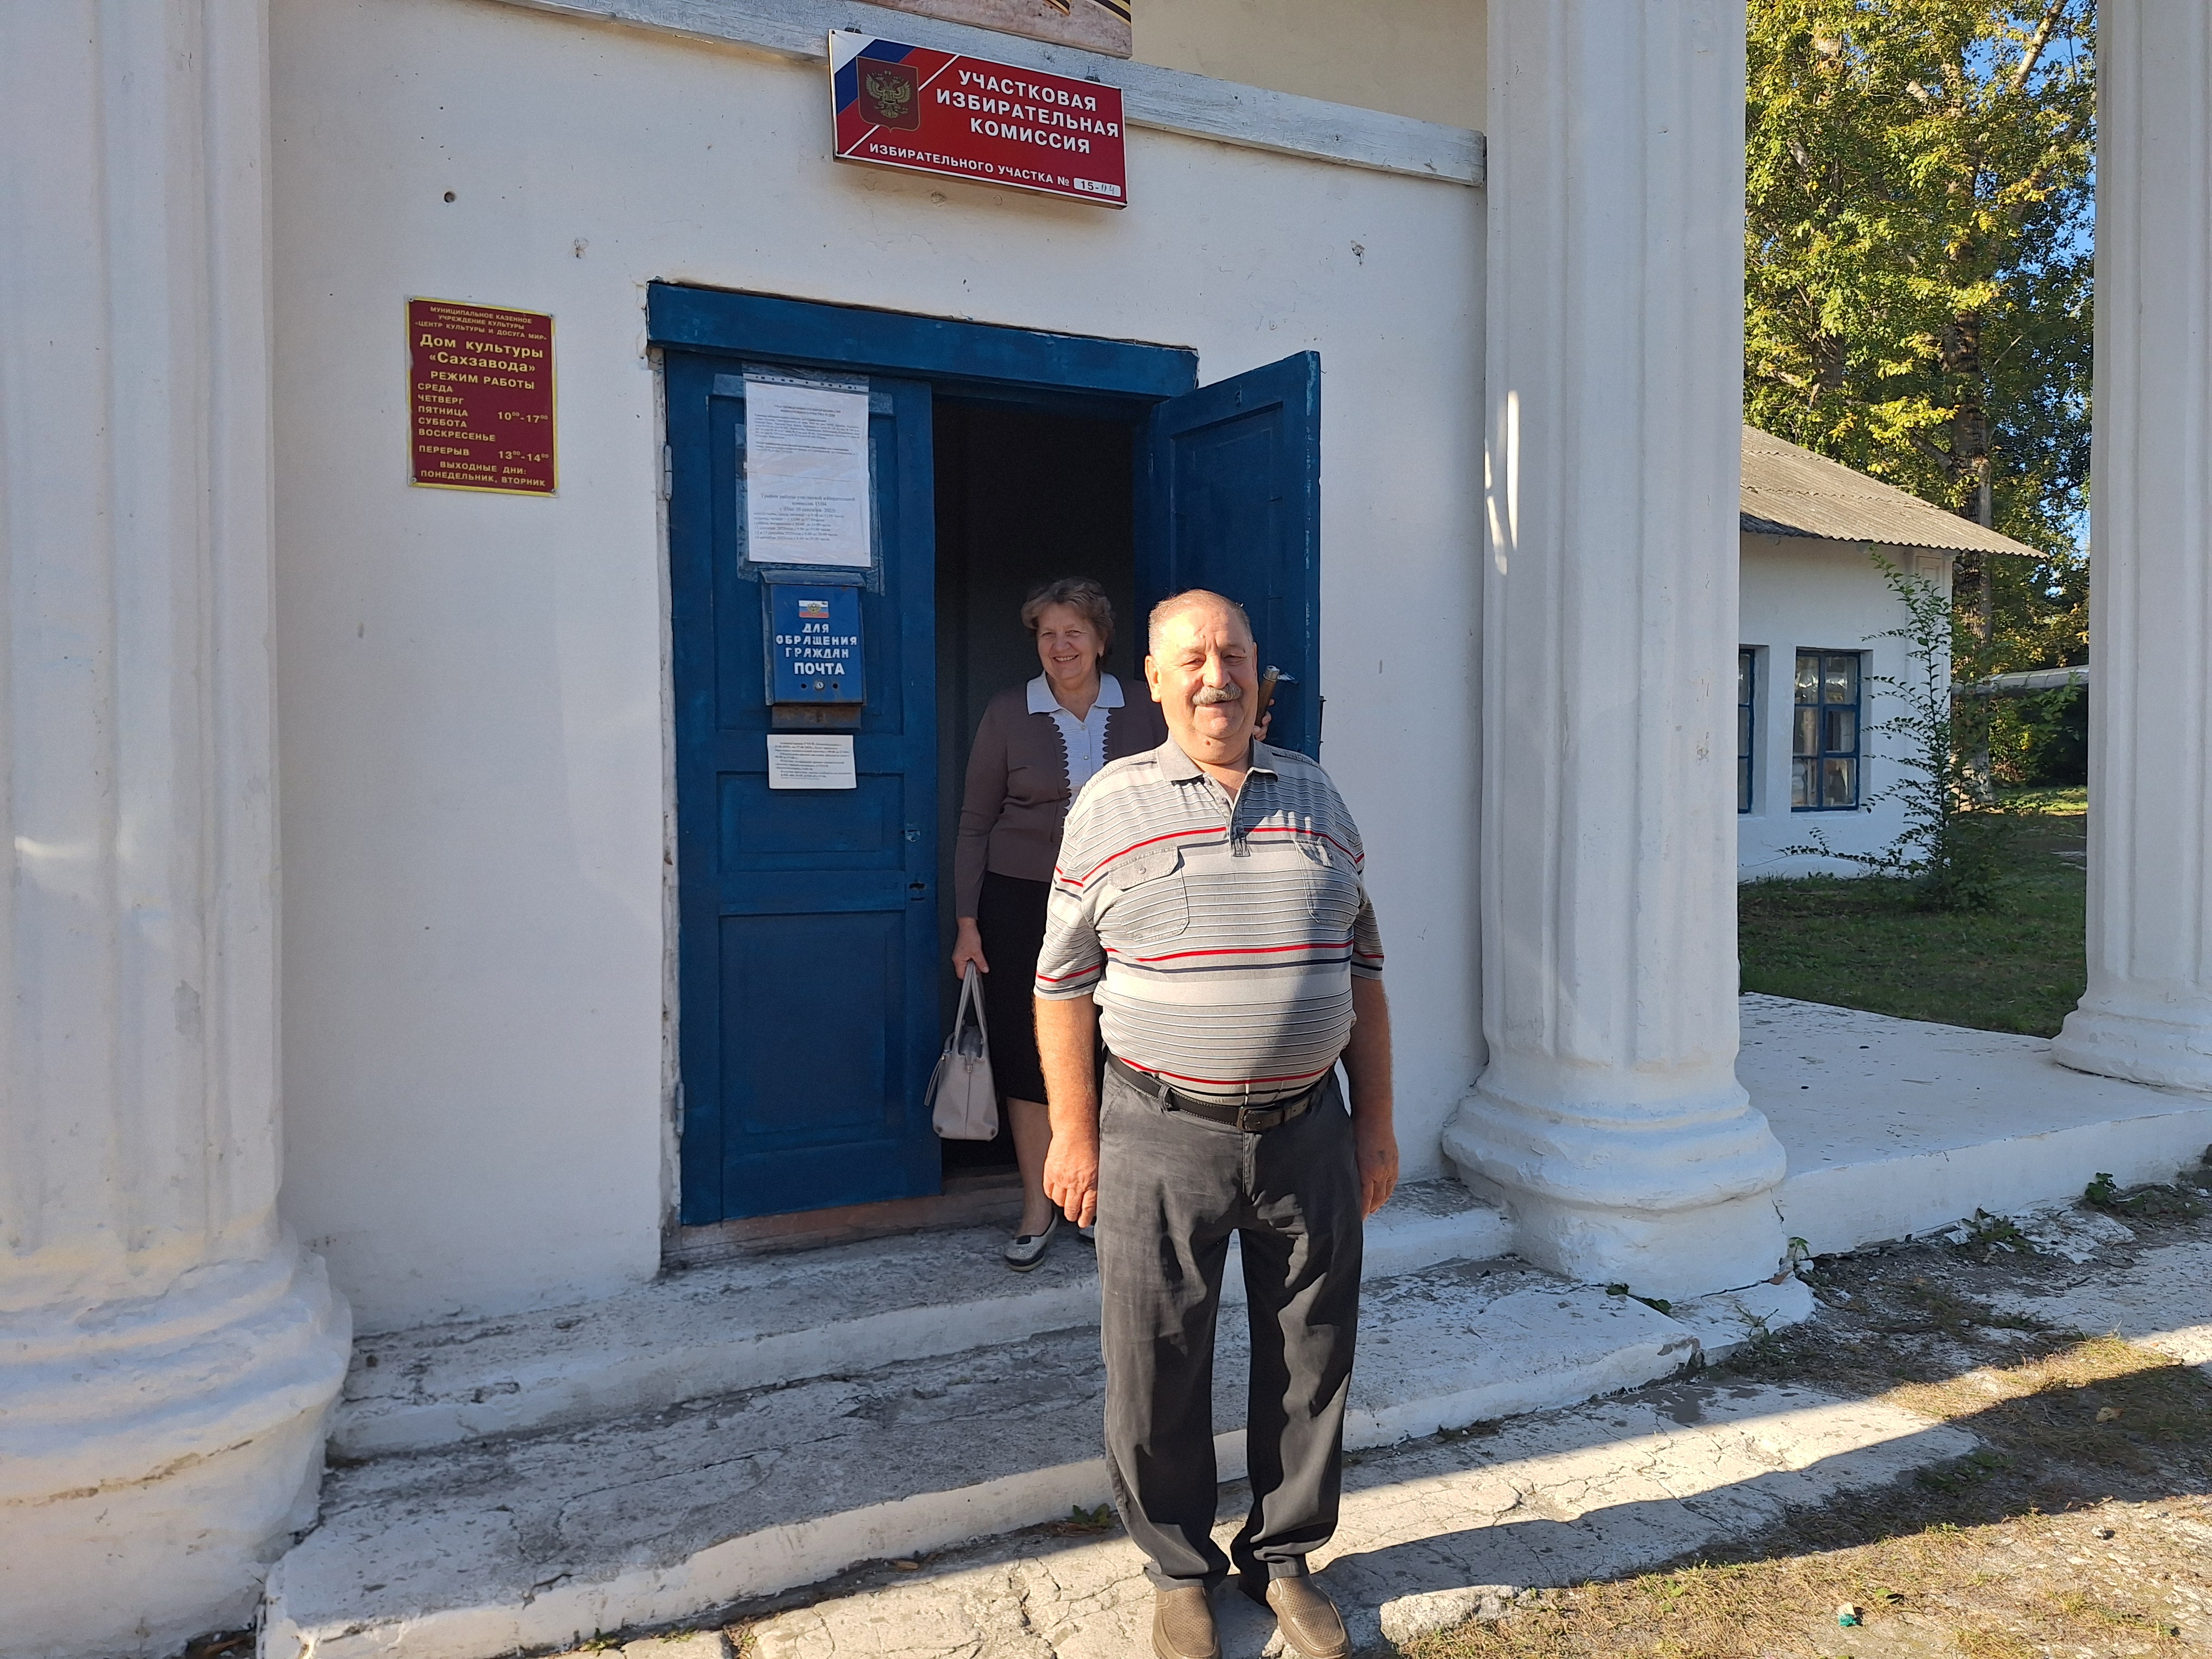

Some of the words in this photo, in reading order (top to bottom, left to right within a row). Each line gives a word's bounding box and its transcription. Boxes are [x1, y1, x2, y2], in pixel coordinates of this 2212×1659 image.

[958, 69, 1096, 112] УЧАСТКОВАЯ
[937, 88, 1119, 138] ИЗБИРАТЕЛЬНАЯ
[970, 117, 1090, 154] КОМИССИЯ
[869, 143, 994, 173] ИЗБИРАТЕЛЬНОГО
[998, 165, 1053, 184] УЧАСТКА
[1057, 176, 1070, 187] №
[430, 306, 493, 319] МУНИЦИПАЛЬНОЕ
[496, 314, 532, 324] КАЗЕННОЕ
[438, 314, 486, 325] УЧРЕЖДЕНИЕ
[488, 320, 524, 330] КУЛЬТУРЫ
[446, 323, 485, 333] КУЛЬТУРЫ
[497, 329, 525, 338] ДОСУГА
[420, 334, 456, 348] Дом
[466, 340, 543, 358] культуры
[429, 352, 535, 372] «Сахзавода»
[430, 371, 478, 383] РЕЖИМ
[484, 376, 535, 390] РАБОТЫ
[417, 383, 454, 393] СРЕДА
[417, 394, 464, 405] ЧЕТВЕРГ
[418, 406, 468, 417] ПЯТНИЦА
[418, 417, 467, 428] СУББОТА
[419, 428, 496, 442] ВОСКРЕСЕНЬЕ
[419, 445, 470, 456] ПЕРЕРЫВ
[440, 461, 497, 473] ВЫХОДНЫЕ
[503, 466, 526, 475] ДНИ:
[421, 470, 498, 484] ПОНЕДЕЛЬНИК,
[501, 477, 545, 487] ВТОРНИК
[802, 623, 829, 633] ДЛЯ
[775, 635, 857, 645] ОБРАЩЕНИЯ
[785, 647, 849, 659] ГРАЖДАН
[794, 662, 845, 675] ПОЧТА
